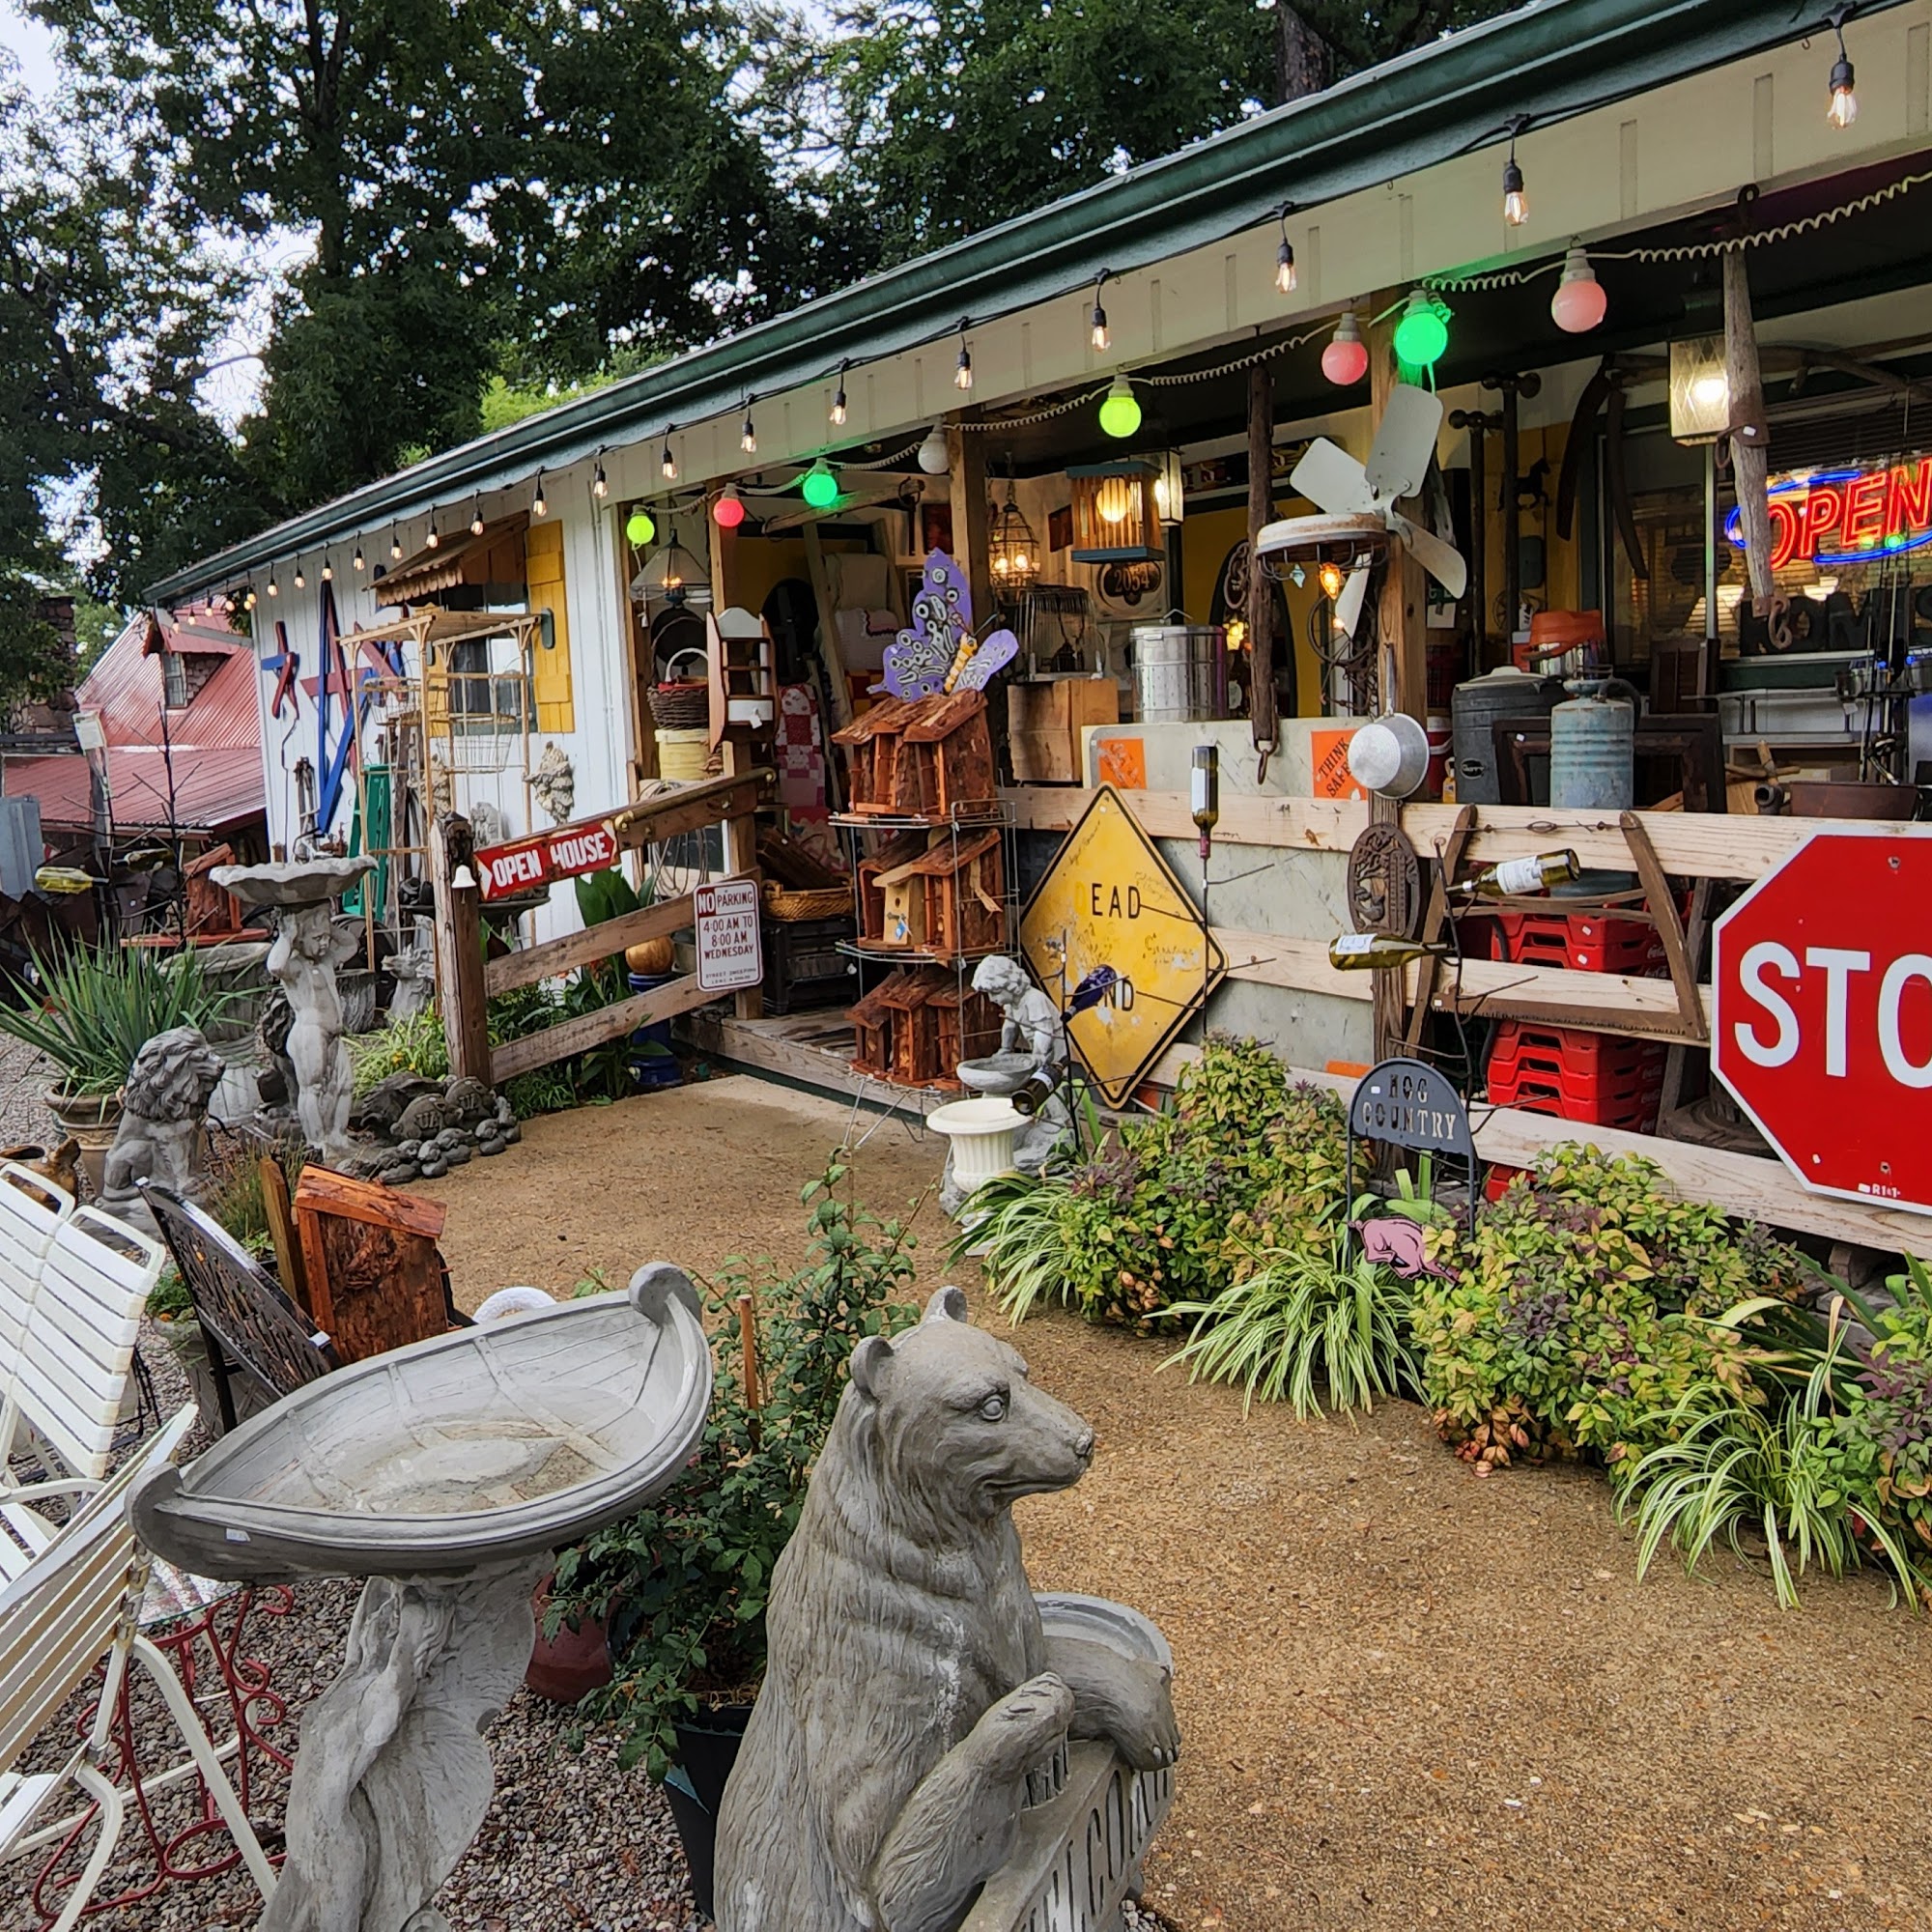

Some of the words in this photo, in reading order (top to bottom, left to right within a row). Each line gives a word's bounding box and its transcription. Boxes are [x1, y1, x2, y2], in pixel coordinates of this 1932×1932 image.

[1769, 458, 1932, 570] OPEN
[1113, 564, 1151, 593] 2054
[1318, 737, 1350, 779] THINK
[492, 849, 543, 888] OPEN
[550, 832, 610, 869] HOUSE
[697, 892, 716, 914] NO
[717, 891, 753, 907] PARKING
[703, 919, 724, 933] 4:00
[726, 919, 740, 931] AM
[743, 915, 753, 927] TO
[704, 944, 753, 959] WEDNESDAY
[711, 933, 731, 948] 8:00
[734, 930, 748, 944] AM
[1103, 978, 1134, 1011] ND
[1389, 1074, 1428, 1103] HOG
[1362, 1101, 1457, 1140] COUNTRY
